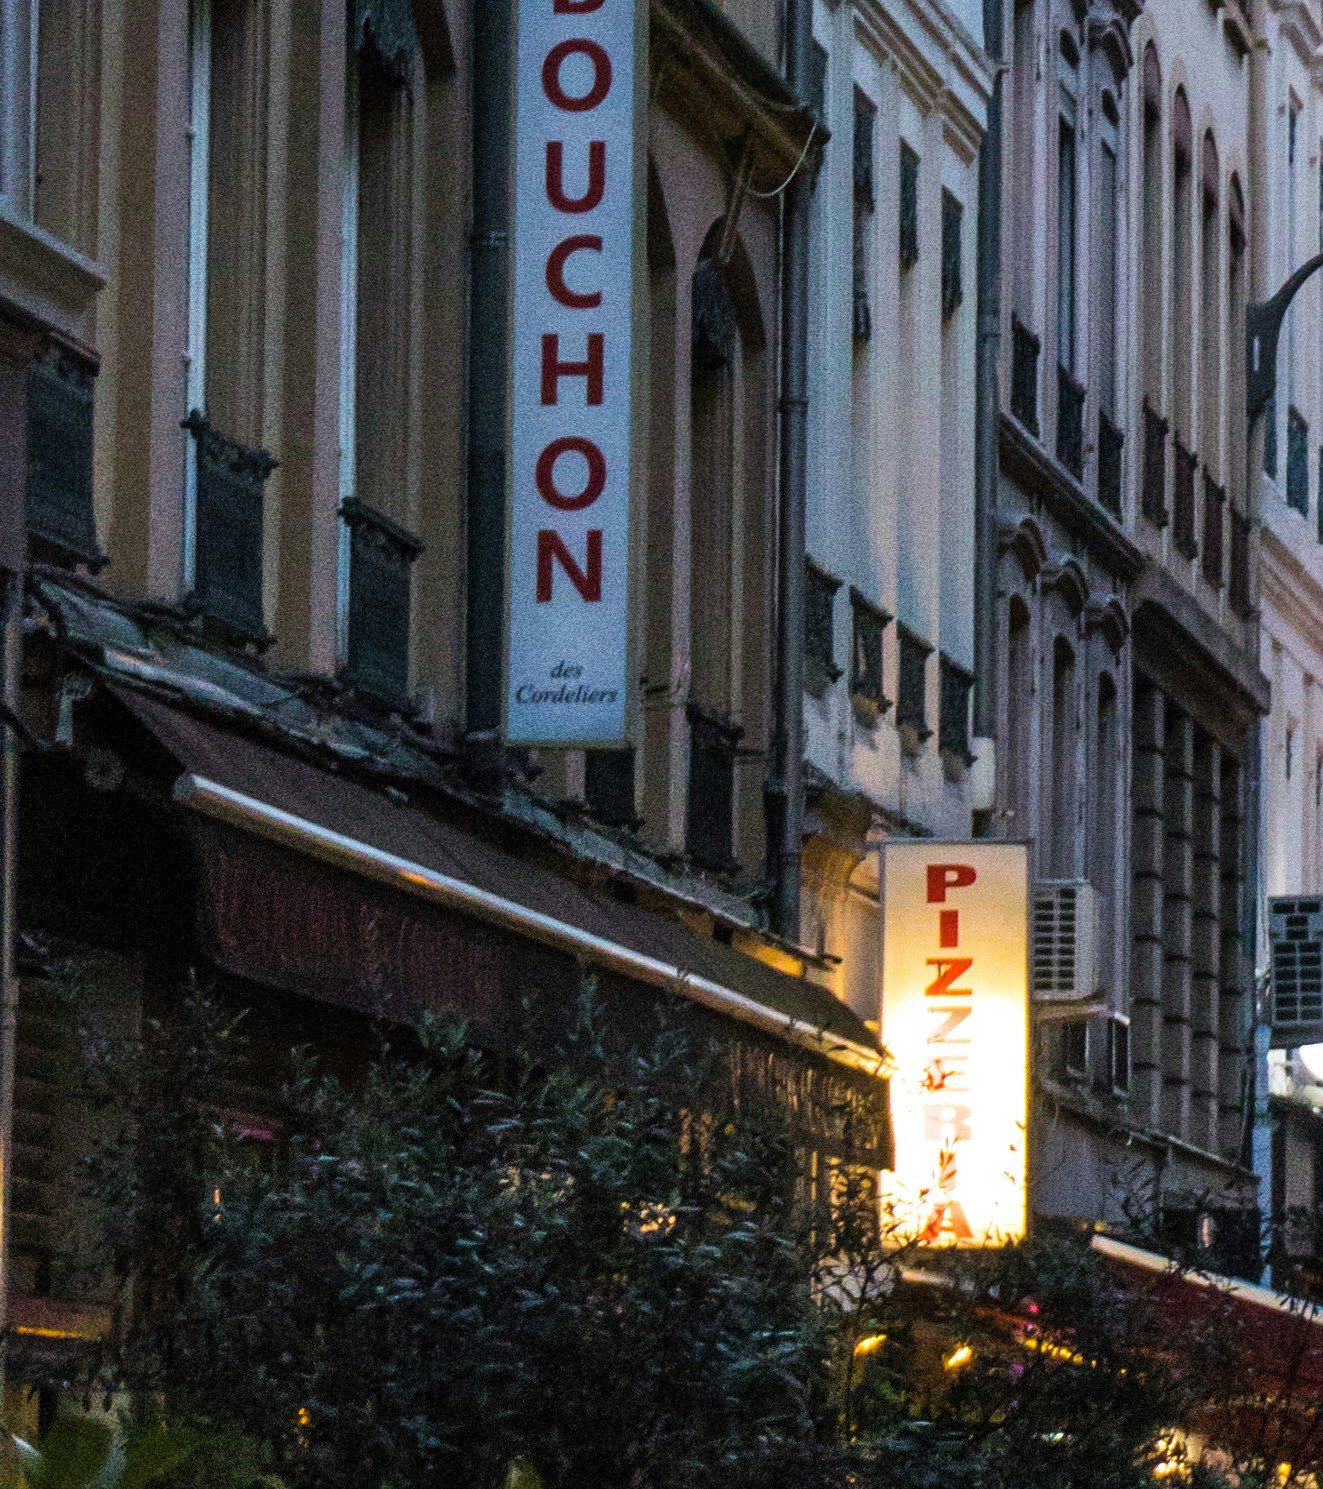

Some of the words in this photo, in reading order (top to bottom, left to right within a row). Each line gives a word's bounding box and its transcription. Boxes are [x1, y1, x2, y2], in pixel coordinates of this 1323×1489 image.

[549, 660, 584, 679] des
[515, 683, 619, 704] Cordeliers
[919, 863, 977, 1238] PIZZERIA
